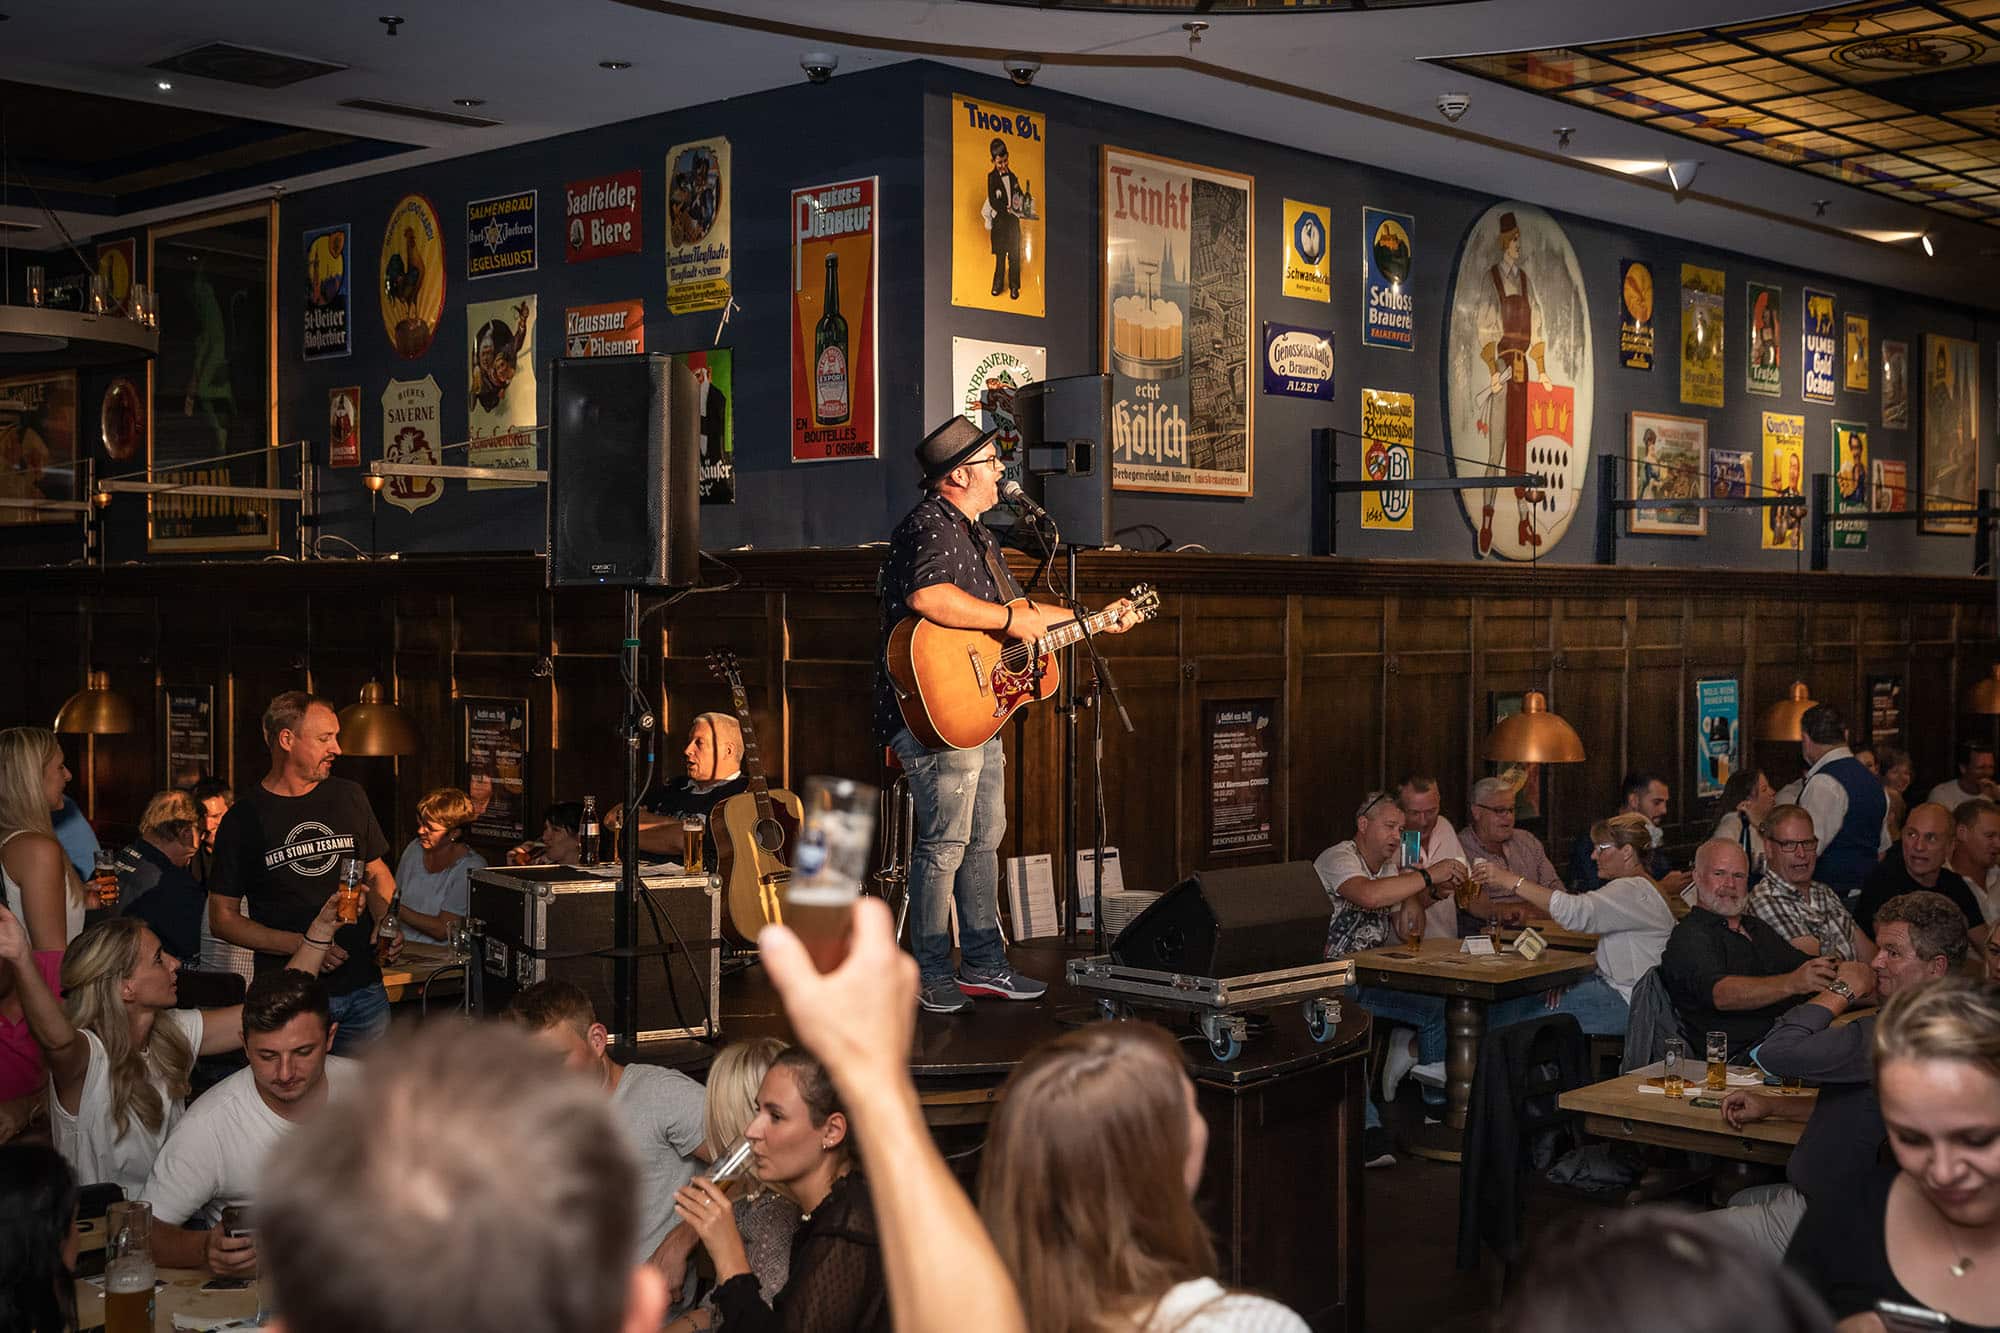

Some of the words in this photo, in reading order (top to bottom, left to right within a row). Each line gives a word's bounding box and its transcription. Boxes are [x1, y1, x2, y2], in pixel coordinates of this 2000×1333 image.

[963, 101, 1014, 135] THOR
[1015, 114, 1041, 142] ØL
[1110, 165, 1190, 232] Trinkt
[591, 218, 632, 247] Biere
[470, 248, 534, 273] LEGELSHURST
[1369, 285, 1414, 312] Schloss
[567, 310, 628, 335] Klaussner
[1368, 307, 1414, 331] Brauerei
[590, 335, 640, 356] Pilsener
[1135, 382, 1161, 400] echt
[1285, 379, 1321, 394] ALZEY
[386, 405, 435, 424] SAVERNE
[803, 427, 857, 444] BOUTEILLES
[1112, 399, 1188, 465] Kölsch
[265, 850, 286, 867] MER
[316, 837, 355, 853] ZESAMME
